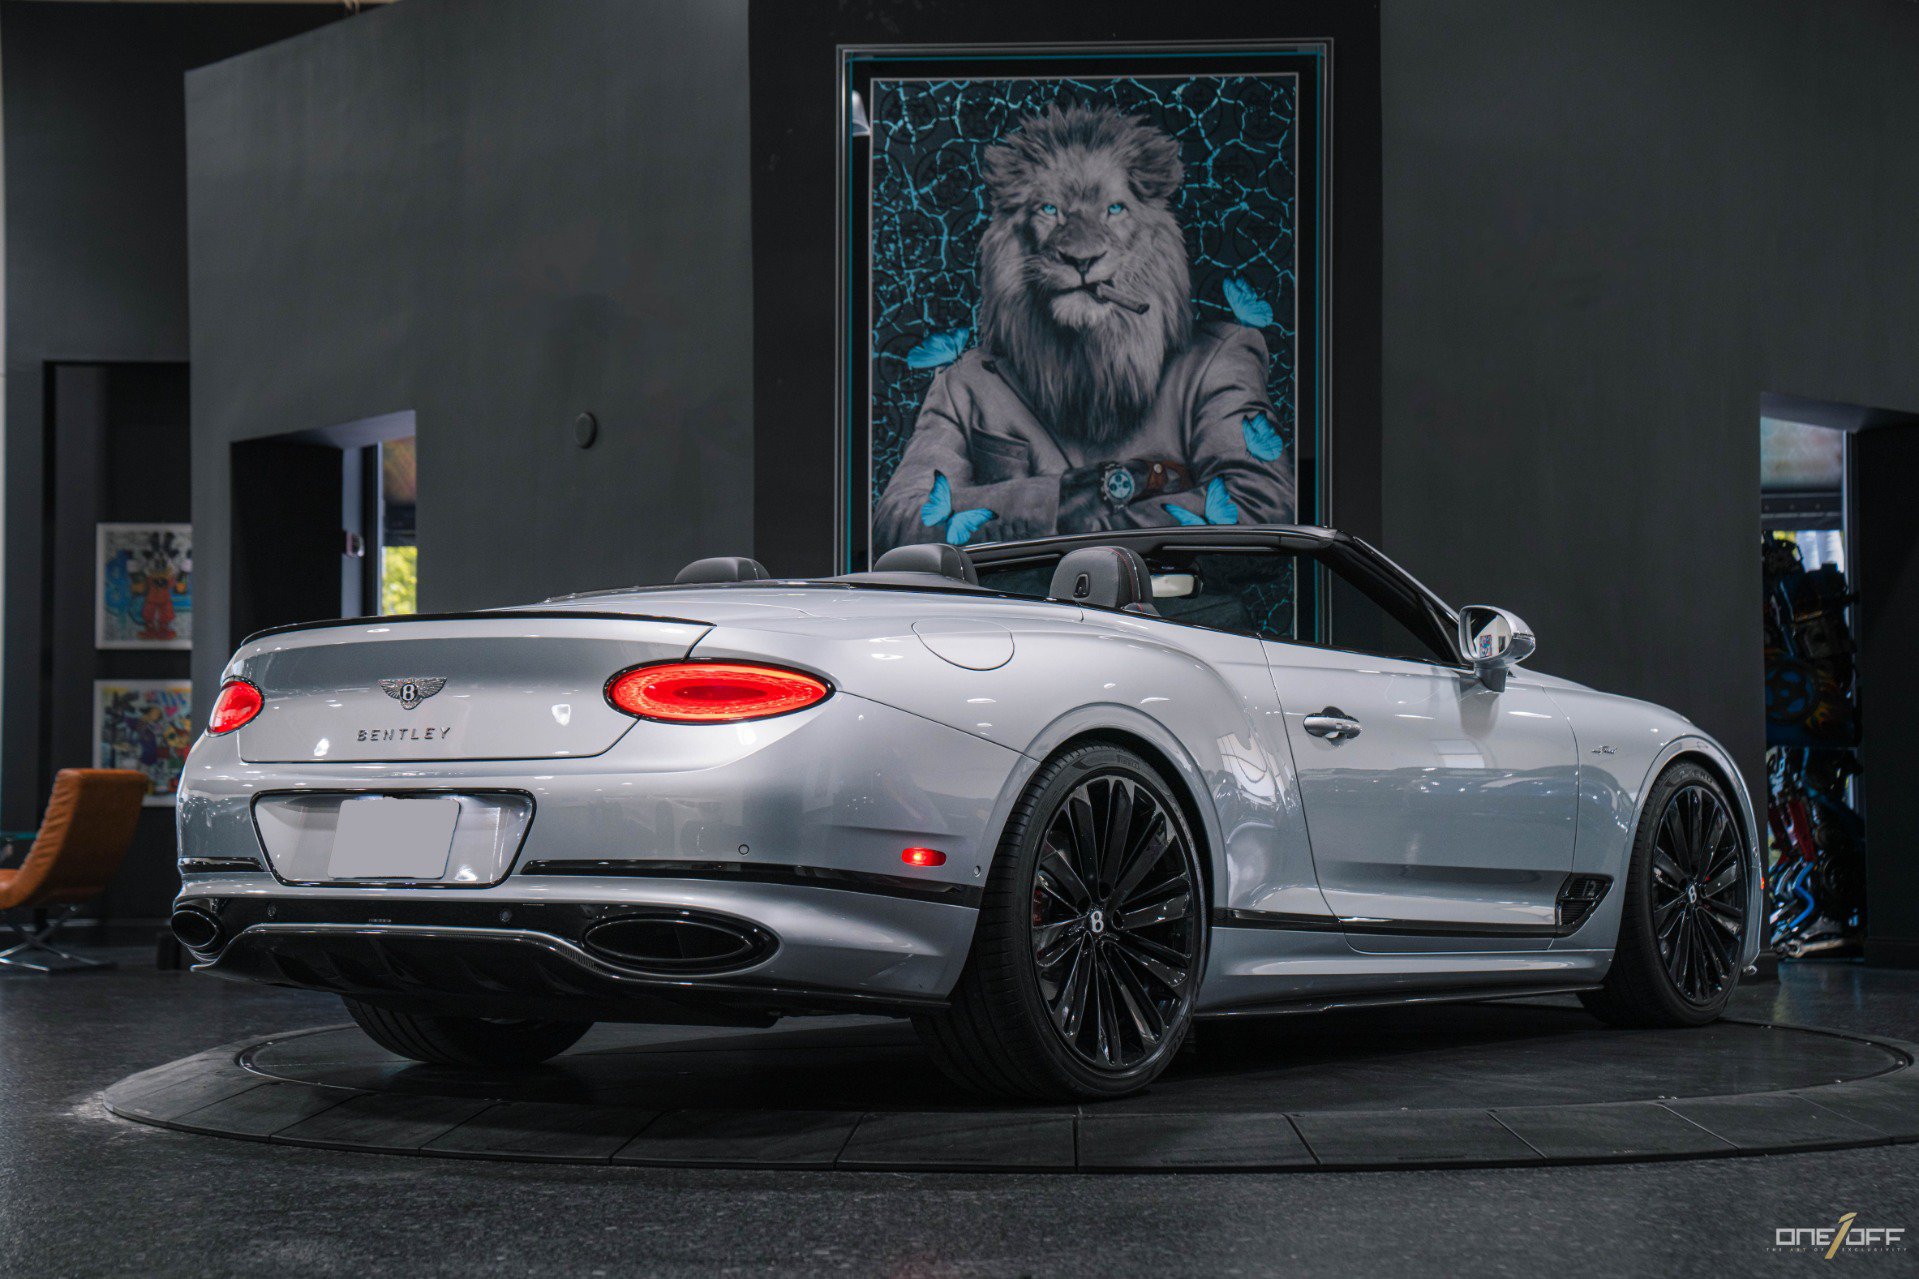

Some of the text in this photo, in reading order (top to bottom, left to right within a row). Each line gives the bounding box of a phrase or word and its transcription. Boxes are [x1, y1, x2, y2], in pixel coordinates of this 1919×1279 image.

[357, 727, 451, 742] BENTLEY
[1582, 880, 1597, 897] 12
[1688, 884, 1697, 904] B
[1091, 910, 1104, 933] B
